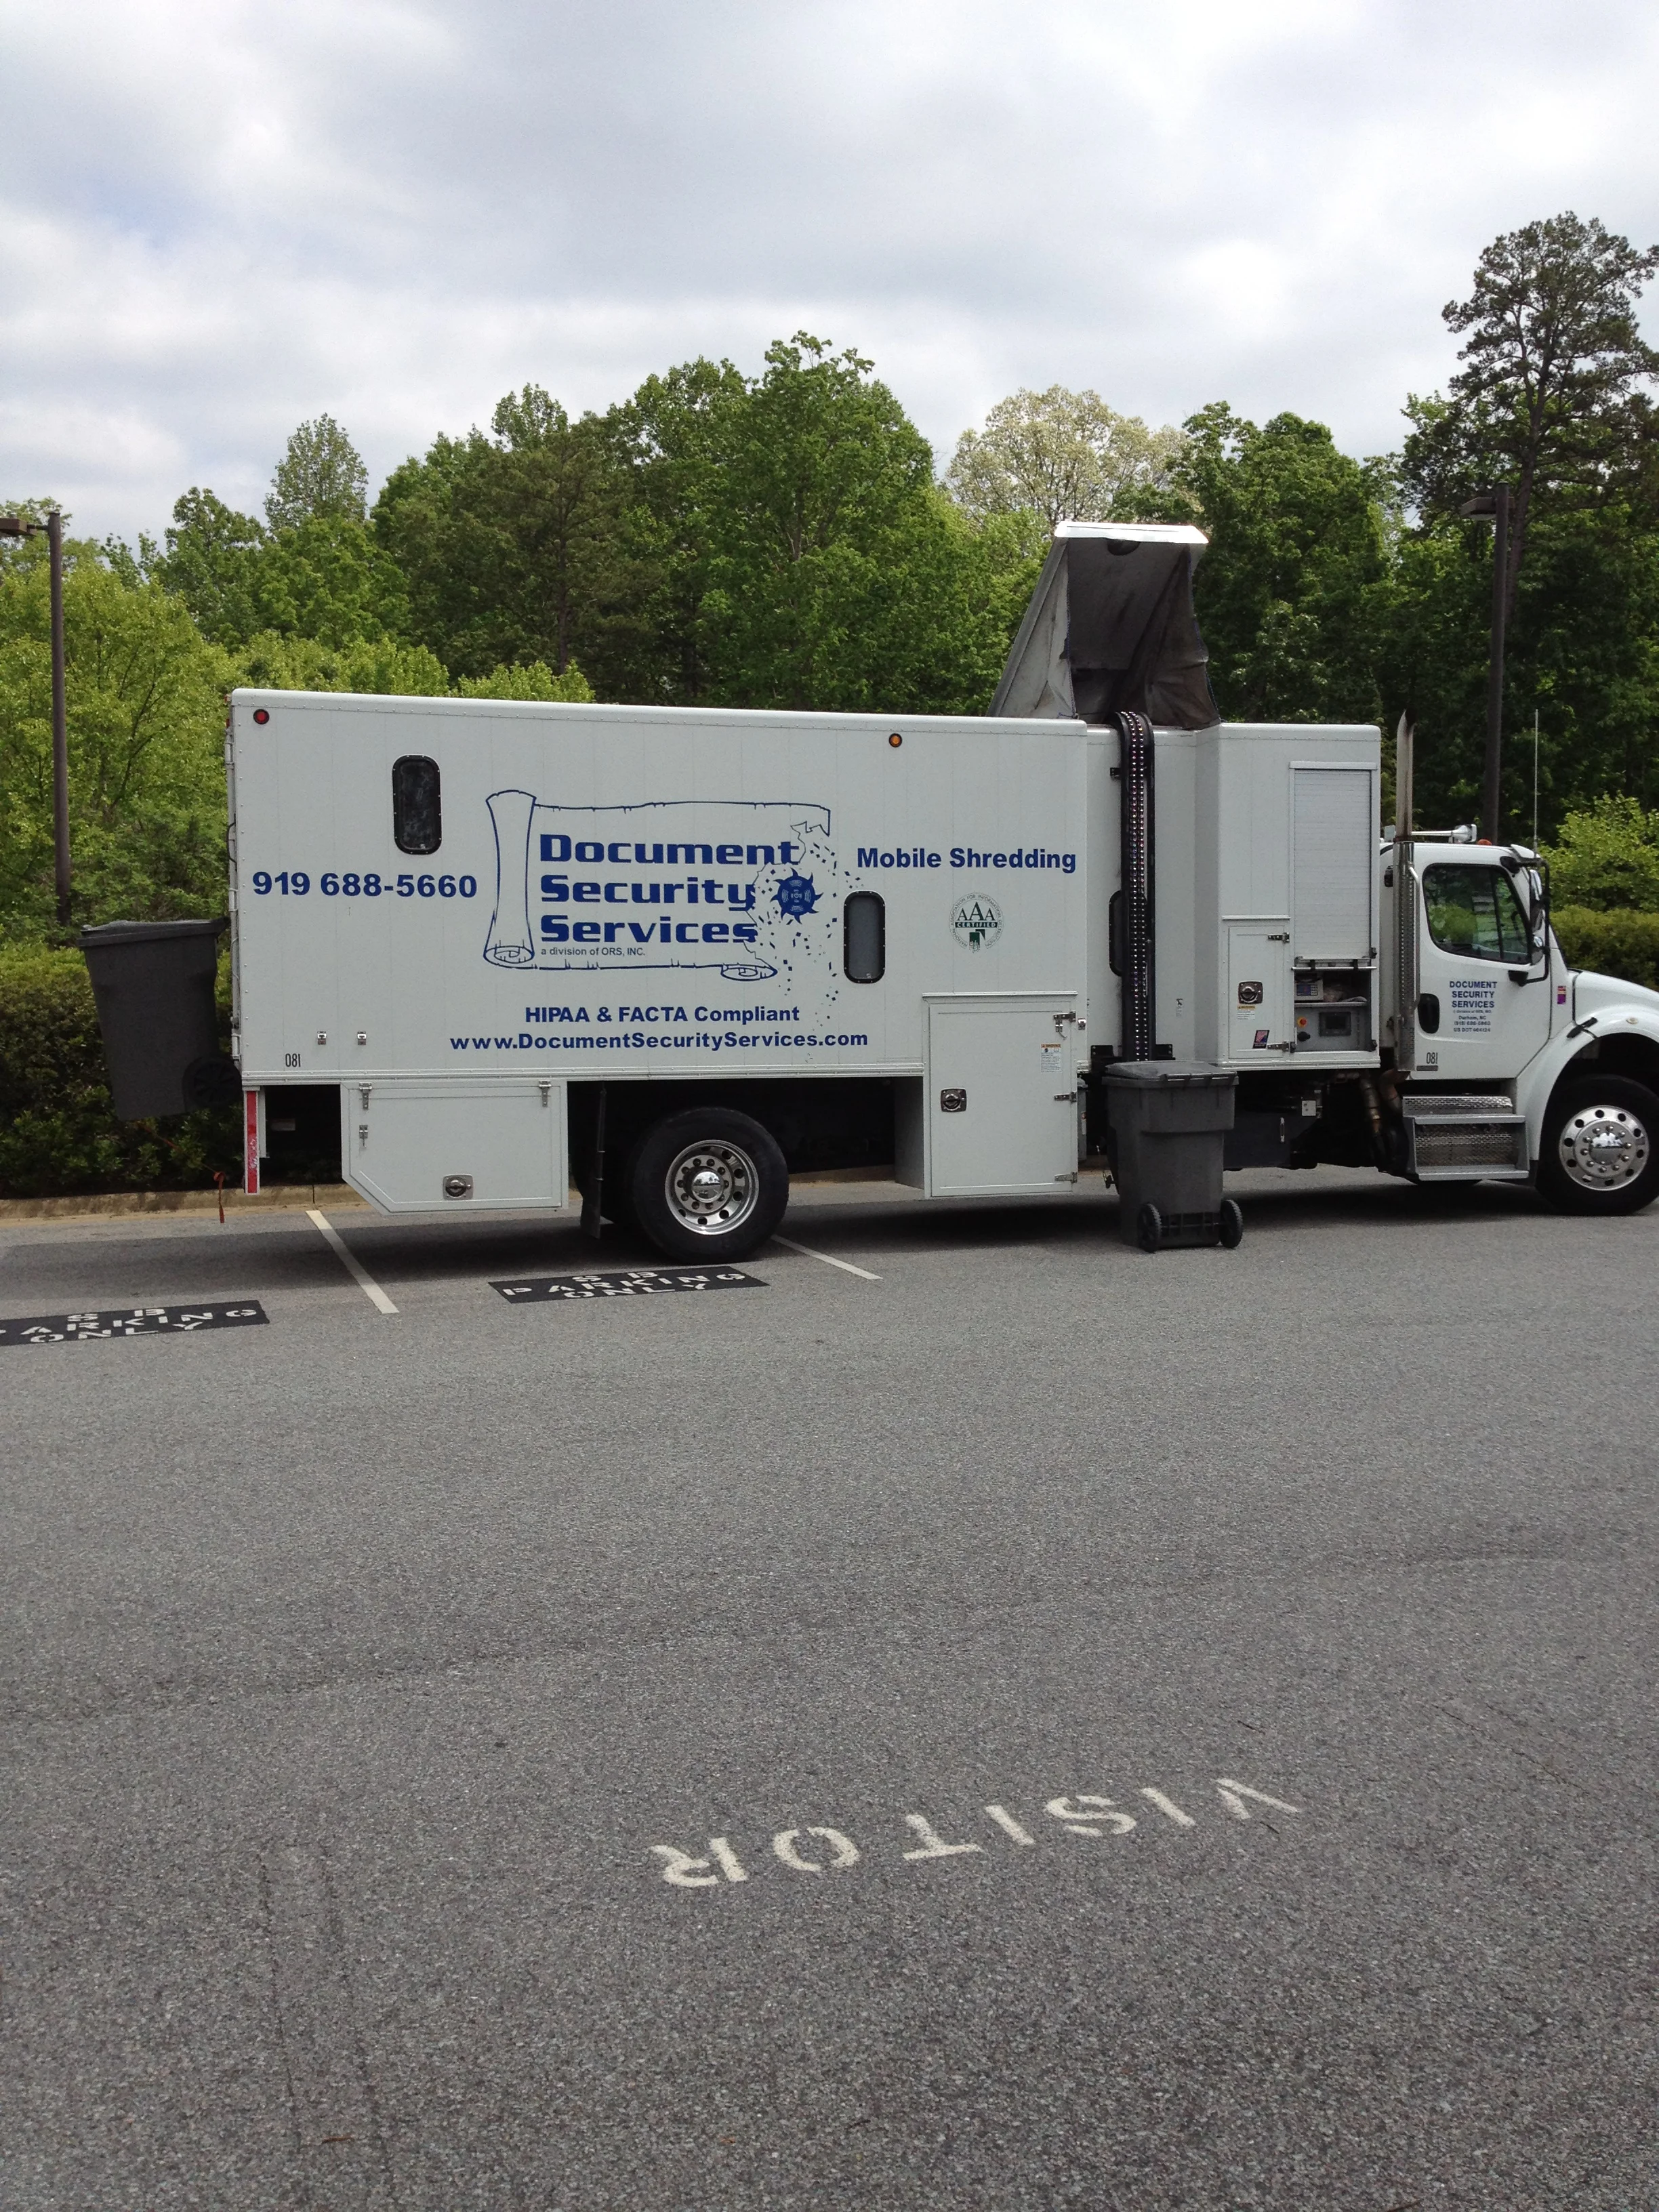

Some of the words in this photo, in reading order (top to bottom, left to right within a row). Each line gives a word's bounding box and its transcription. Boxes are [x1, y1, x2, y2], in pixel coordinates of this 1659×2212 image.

[540, 834, 799, 865] Document
[857, 848, 941, 868] Mobile
[950, 848, 1076, 873] Shredding
[253, 872, 310, 895] 919
[321, 873, 477, 897] 688-5660
[541, 874, 756, 912] Security
[957, 901, 996, 921] AAA
[541, 915, 758, 943] Services
[550, 947, 587, 956] division
[590, 947, 600, 956] of
[601, 947, 625, 957] ORS,
[1449, 981, 1498, 989] DOCUMENT
[1452, 990, 1495, 998] SECURITY
[1452, 1000, 1495, 1008] SERVICES
[525, 1007, 590, 1022] HIPAA
[597, 1007, 613, 1022] &
[619, 1007, 688, 1022] FACTA
[695, 1006, 800, 1025] Compliant
[450, 1031, 867, 1052] www.DocumentSecurityServices.com
[502, 1273, 745, 1296] PARKING
[563, 1283, 707, 1299] ONLY
[0, 1309, 258, 1335] ARKING
[30, 1322, 203, 1343] ONLY
[649, 1778, 1302, 1887] VISITOR
